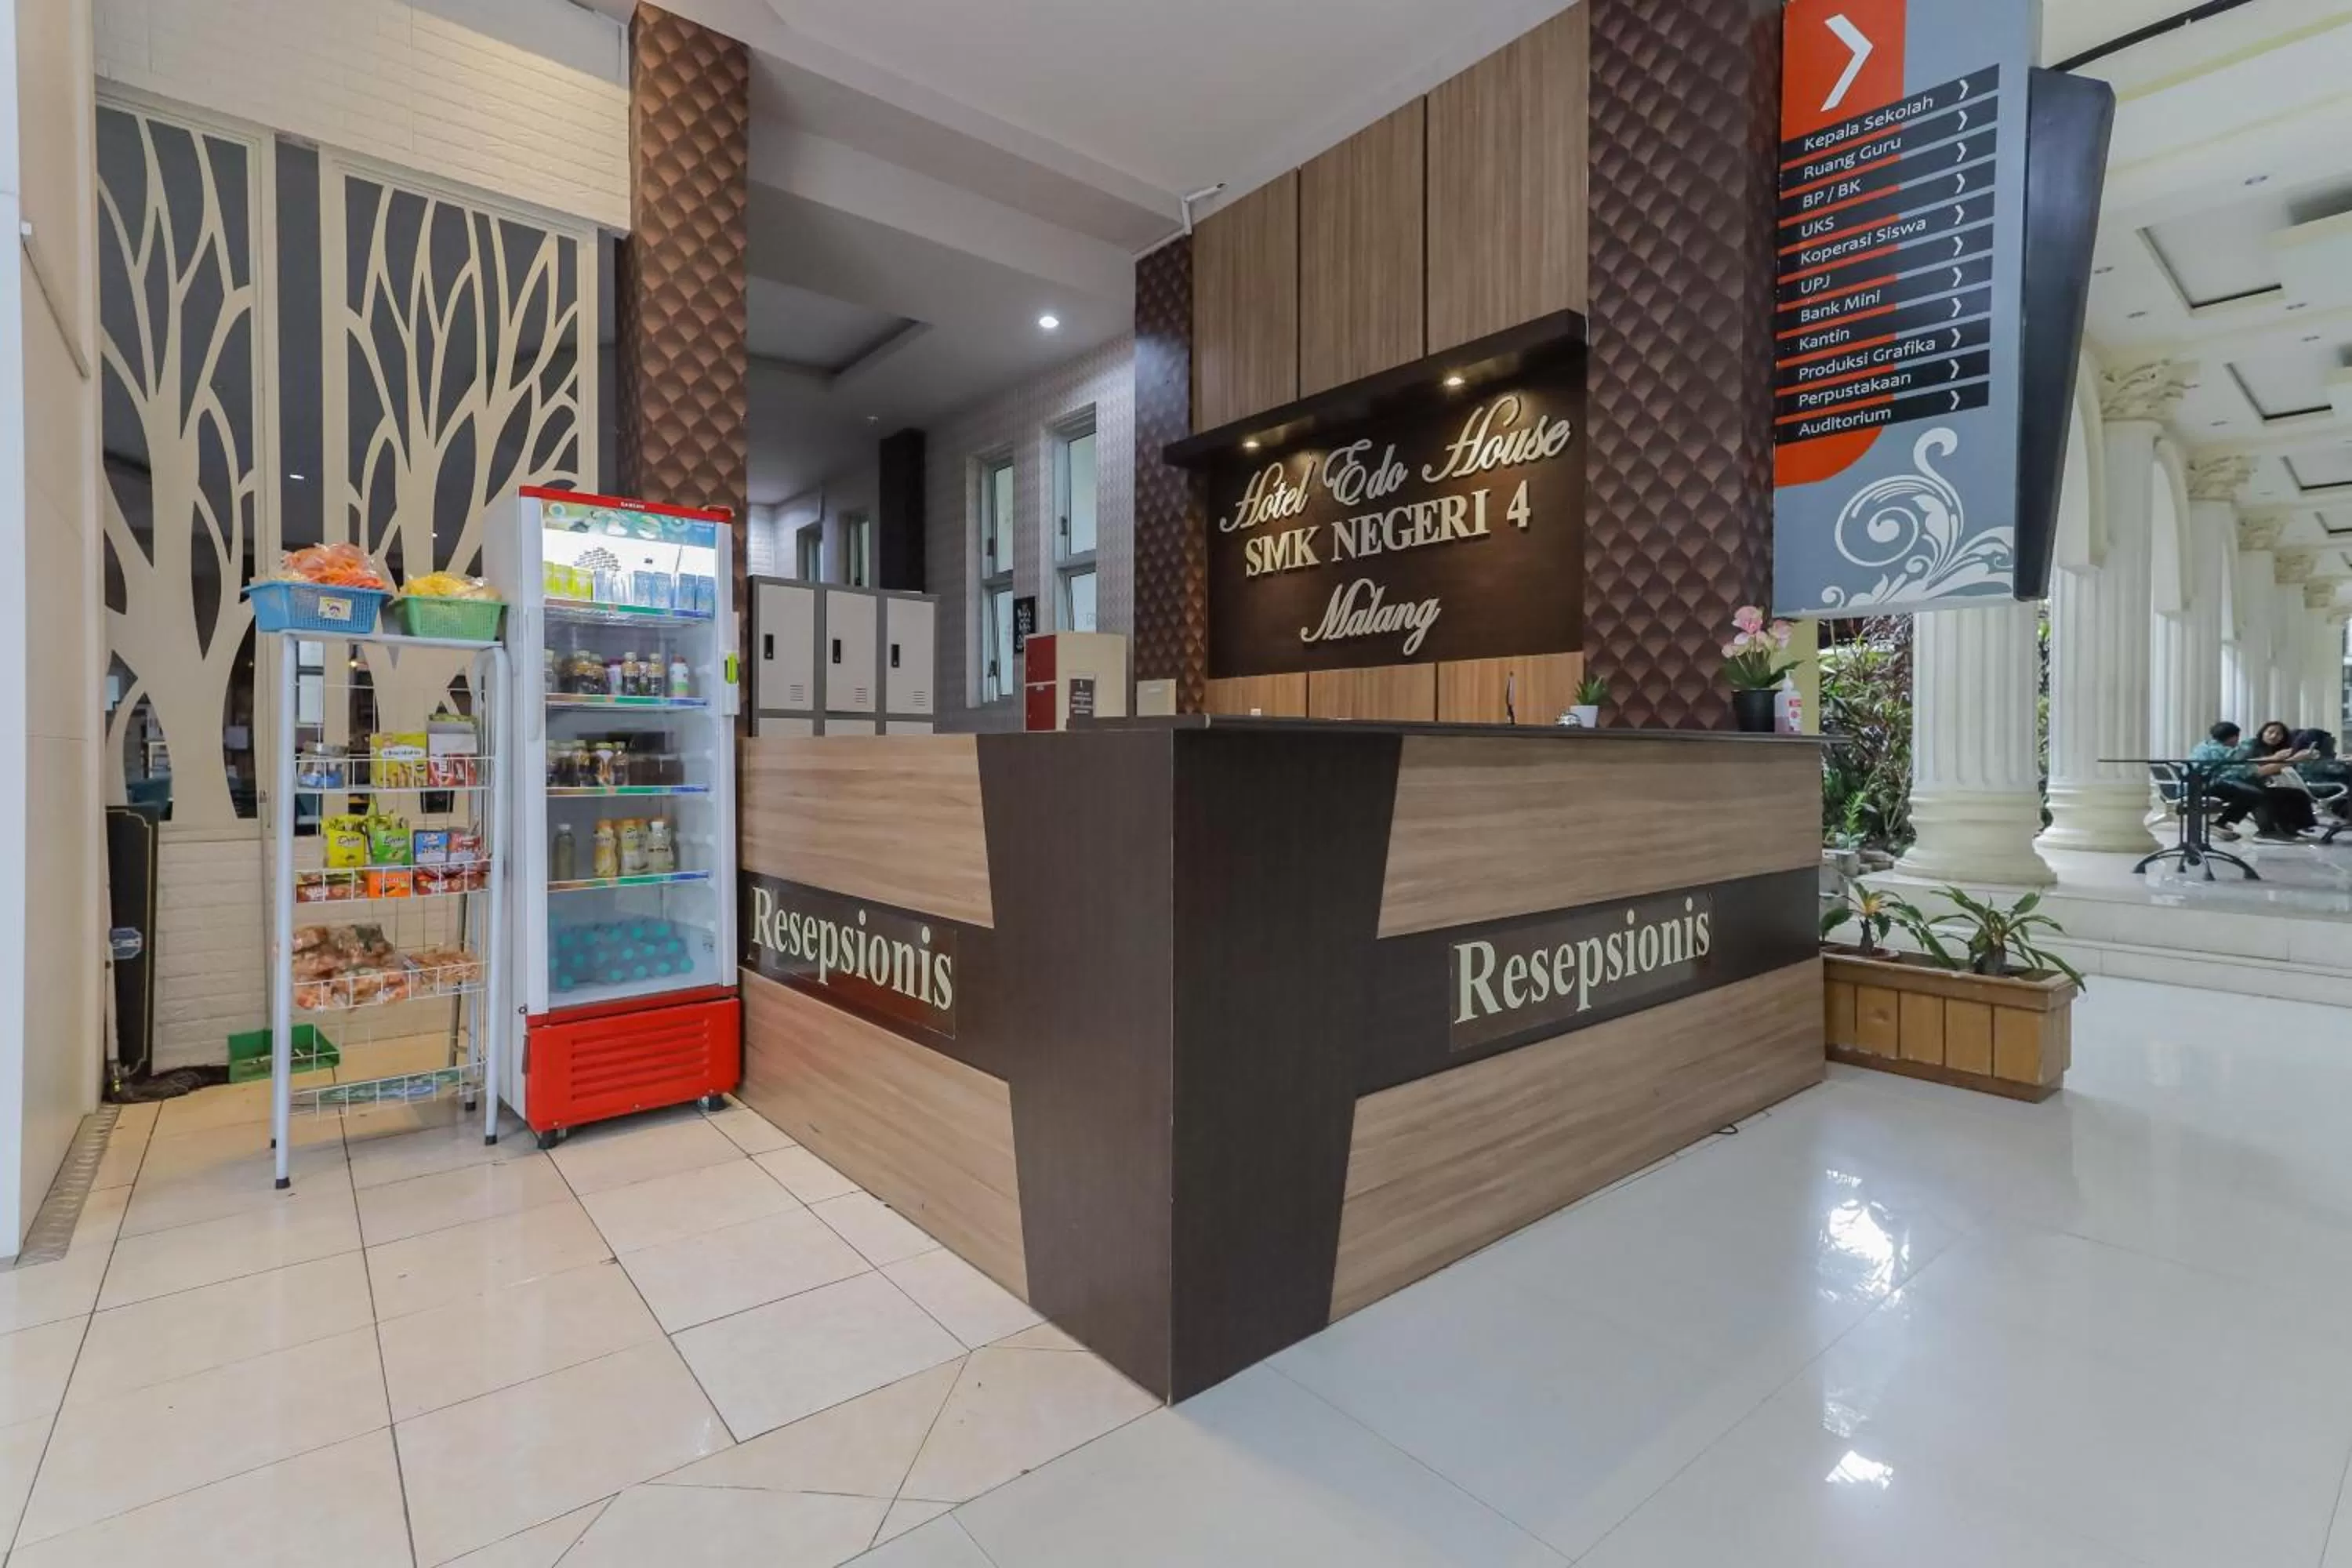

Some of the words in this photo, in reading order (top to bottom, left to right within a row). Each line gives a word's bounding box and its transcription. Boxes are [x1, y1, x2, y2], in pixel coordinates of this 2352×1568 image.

[1805, 122, 1859, 151] Kepala
[1864, 96, 1933, 131] Sekolah
[1804, 152, 1854, 179] Ruang
[1860, 136, 1901, 158] Guru
[1803, 187, 1825, 208] BP
[1838, 179, 1860, 198] BK
[1801, 216, 1835, 237] UKS
[1801, 234, 1871, 265] Koperasi
[1877, 219, 1927, 244] Siswa
[1801, 274, 1830, 294] UPJ
[1801, 300, 1840, 322] Bank
[1844, 290, 1881, 312] Mini
[1799, 328, 1850, 351] Kantin
[1799, 351, 1868, 380] Produksi
[1874, 338, 1936, 362] Grafika
[1798, 372, 1911, 407] Perpustakaan
[1798, 408, 1892, 437] Auditorium
[1219, 460, 1316, 533] Hotel
[1323, 439, 1408, 506] Edo
[1422, 394, 1571, 484] House
[1245, 526, 1321, 578] SMK
[1331, 489, 1491, 562] NEGERI
[1506, 480, 1531, 529] 4
[1301, 578, 1441, 655] Malang
[752, 887, 953, 1011] Resepsionis
[1454, 896, 1710, 1025] Resepsionis
